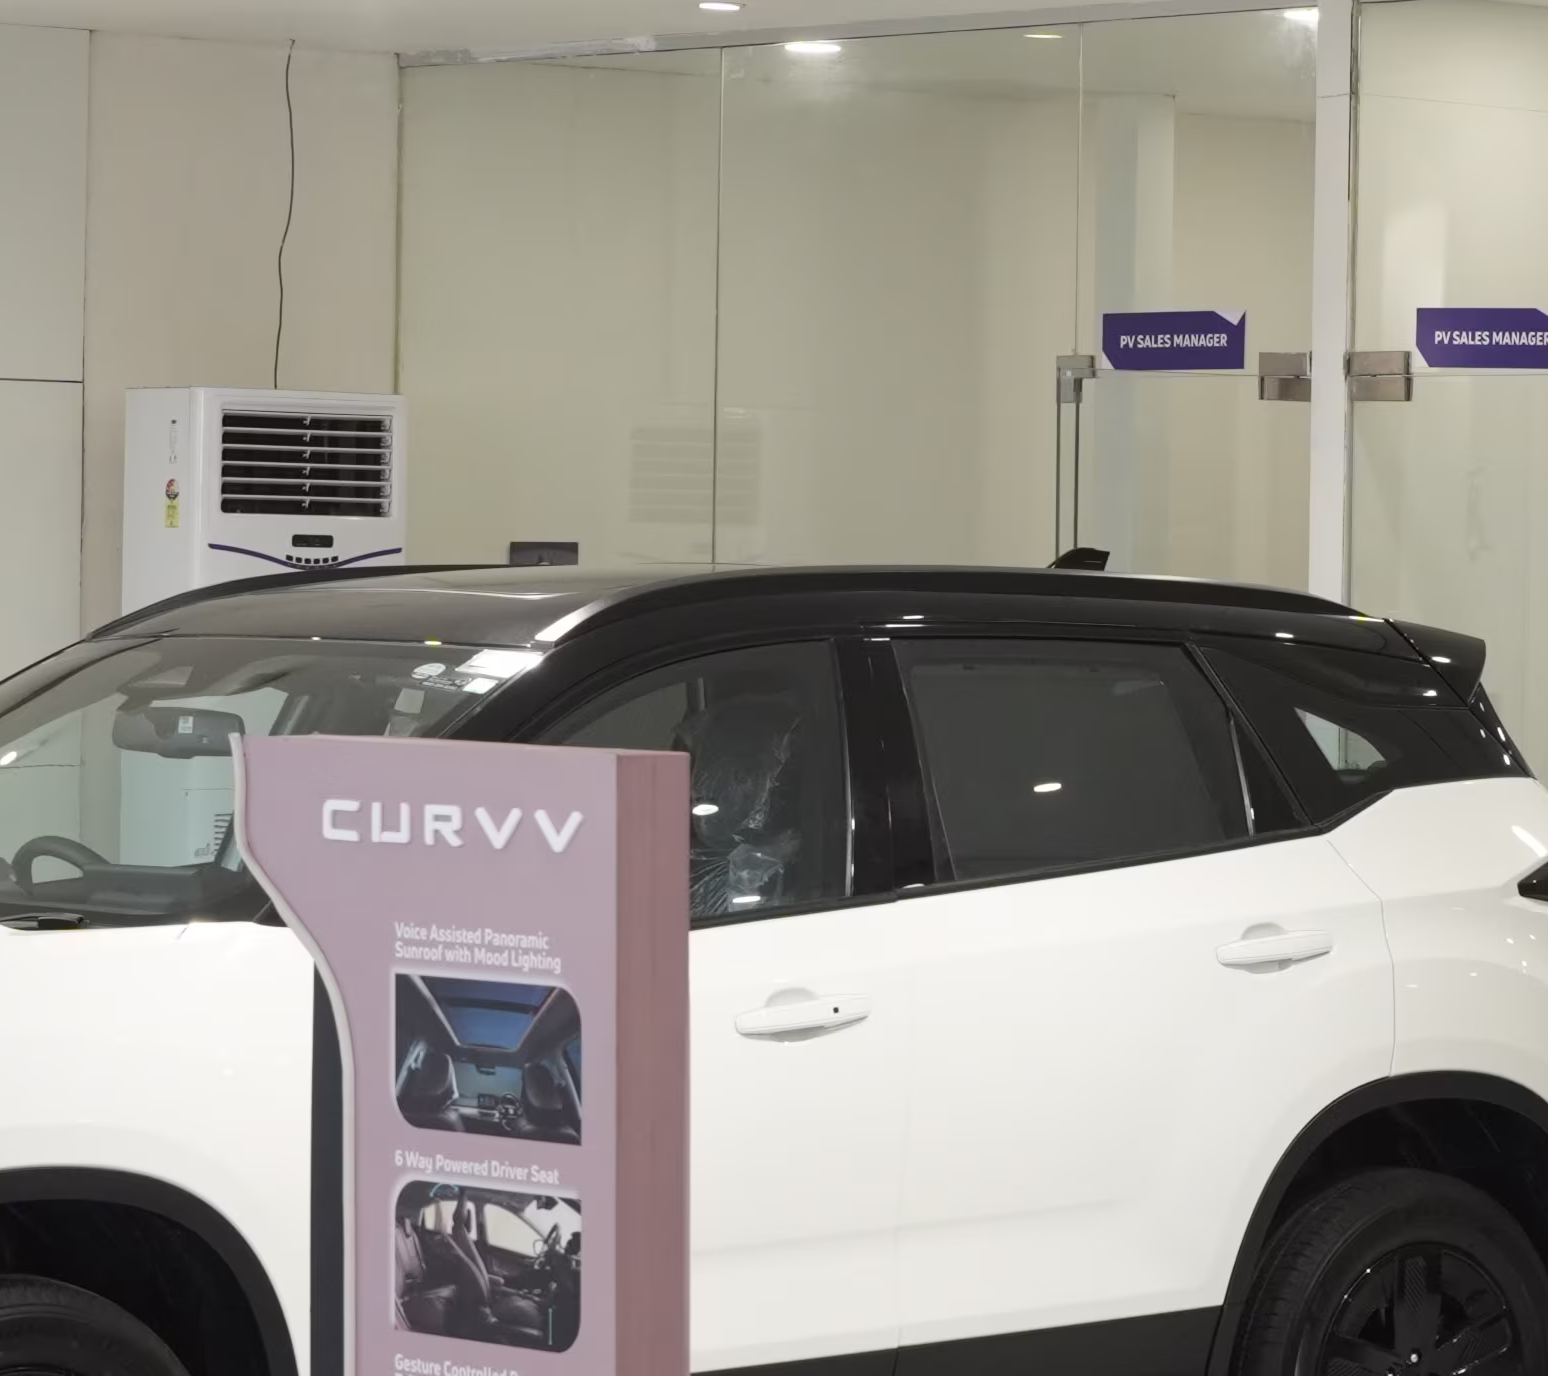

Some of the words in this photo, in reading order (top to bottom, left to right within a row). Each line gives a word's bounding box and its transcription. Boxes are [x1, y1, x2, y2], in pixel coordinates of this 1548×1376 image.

[1120, 334, 1134, 348] PV
[1137, 334, 1171, 348] SALES
[1173, 334, 1228, 348] MANAGER
[1434, 331, 1449, 345] PV
[1452, 331, 1489, 345] SALES
[321, 799, 583, 853] CURVV
[395, 922, 427, 940] Voice
[430, 924, 481, 944] Assisted
[484, 929, 549, 950] Panoramic
[395, 941, 443, 961] Sunroof
[444, 945, 471, 964] with
[474, 948, 508, 967] Mood
[511, 951, 561, 974] Lighting
[395, 1150, 403, 1166] 6
[405, 1151, 432, 1173] Way
[436, 1154, 488, 1176] Powered
[491, 1161, 529, 1181] Driver
[531, 1165, 559, 1185] Seat
[395, 1354, 441, 1376] Gesture
